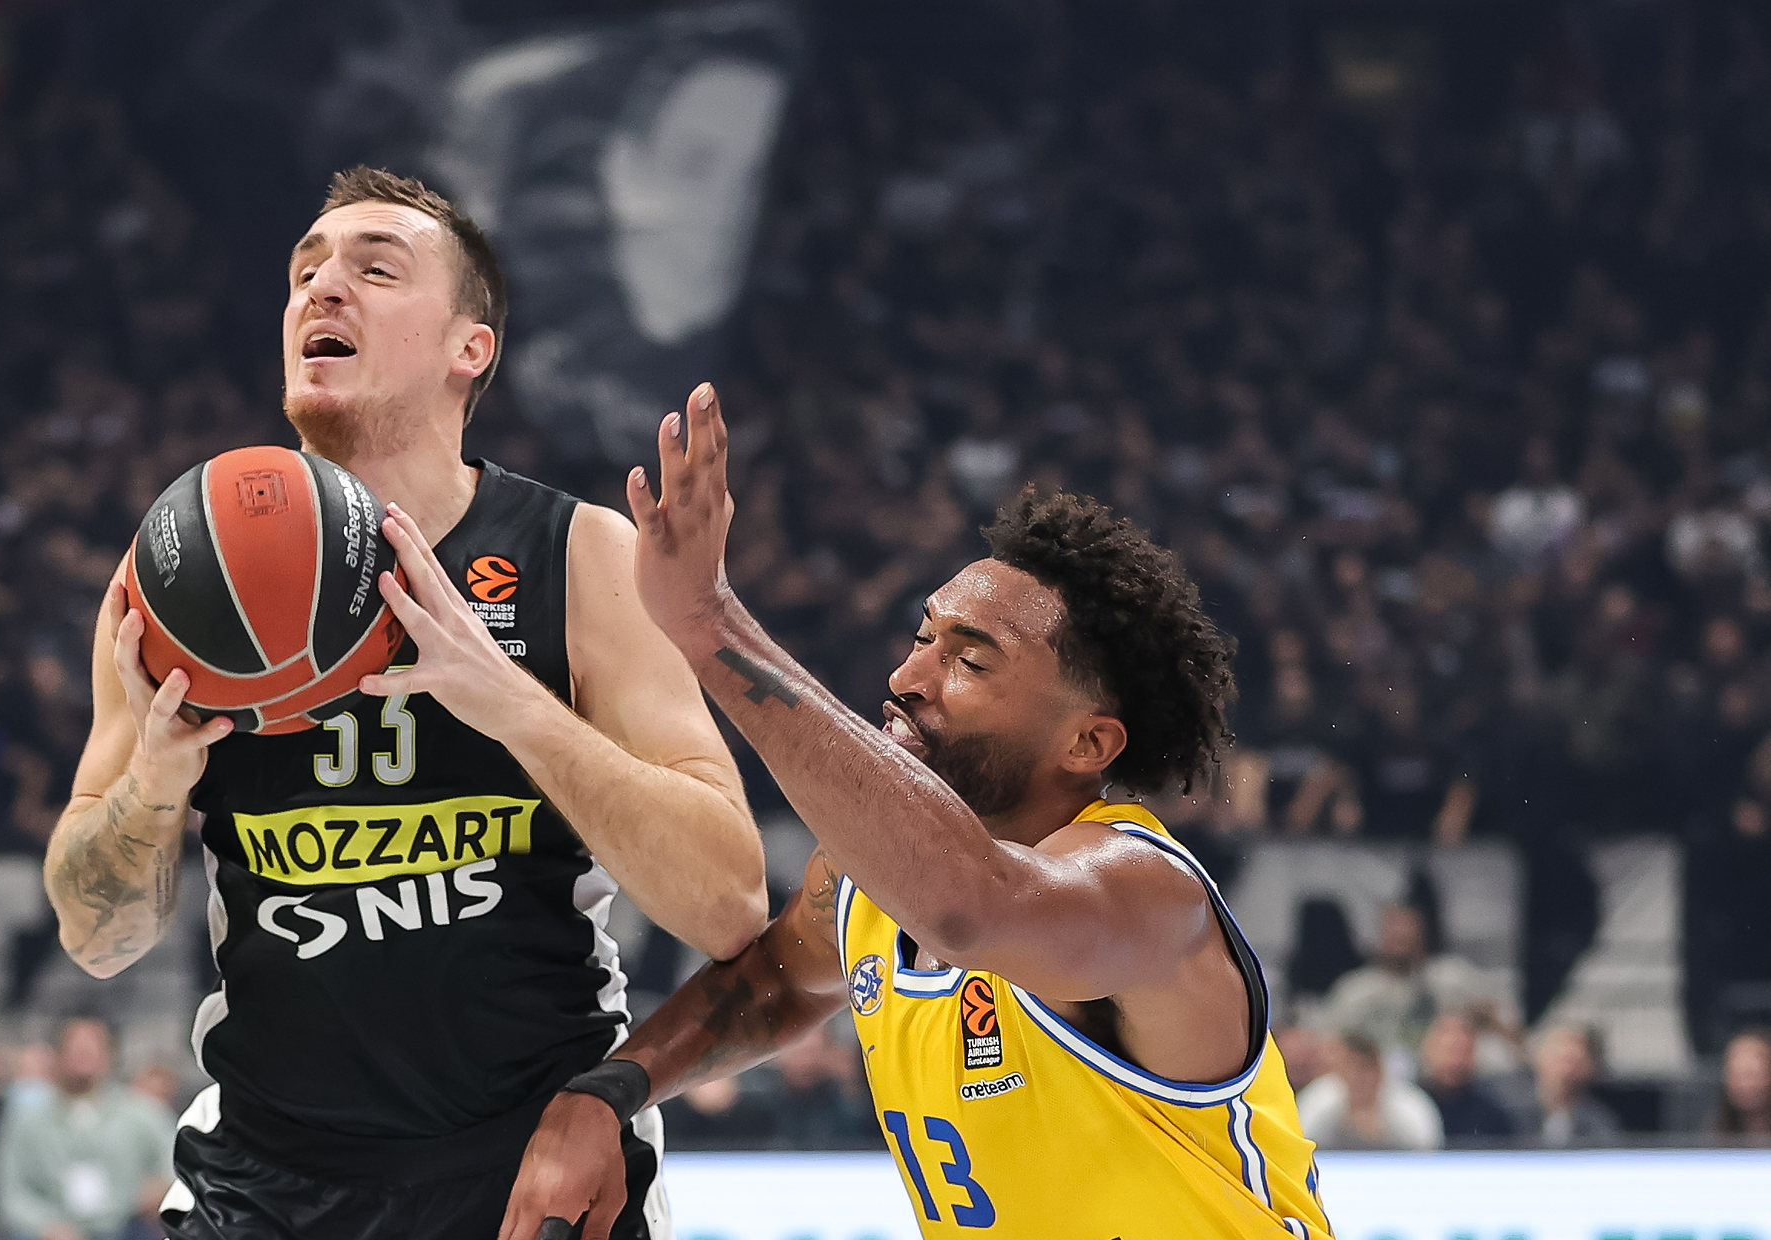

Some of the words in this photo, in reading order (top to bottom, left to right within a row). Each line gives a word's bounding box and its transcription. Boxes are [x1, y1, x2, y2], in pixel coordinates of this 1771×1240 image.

[349, 534, 377, 618] AIRLINES
[468, 602, 516, 612] TURKISH
[475, 611, 515, 621] RLINES
[246, 806, 523, 875] MOZZART
[356, 858, 503, 941] NIS
[967, 1036, 999, 1048] TURKISH
[968, 1046, 1000, 1058] AIRLINES
[968, 1056, 1000, 1066] EuroLeague
[961, 1074, 1025, 1099] oneteam
[884, 1110, 996, 1228] 13
